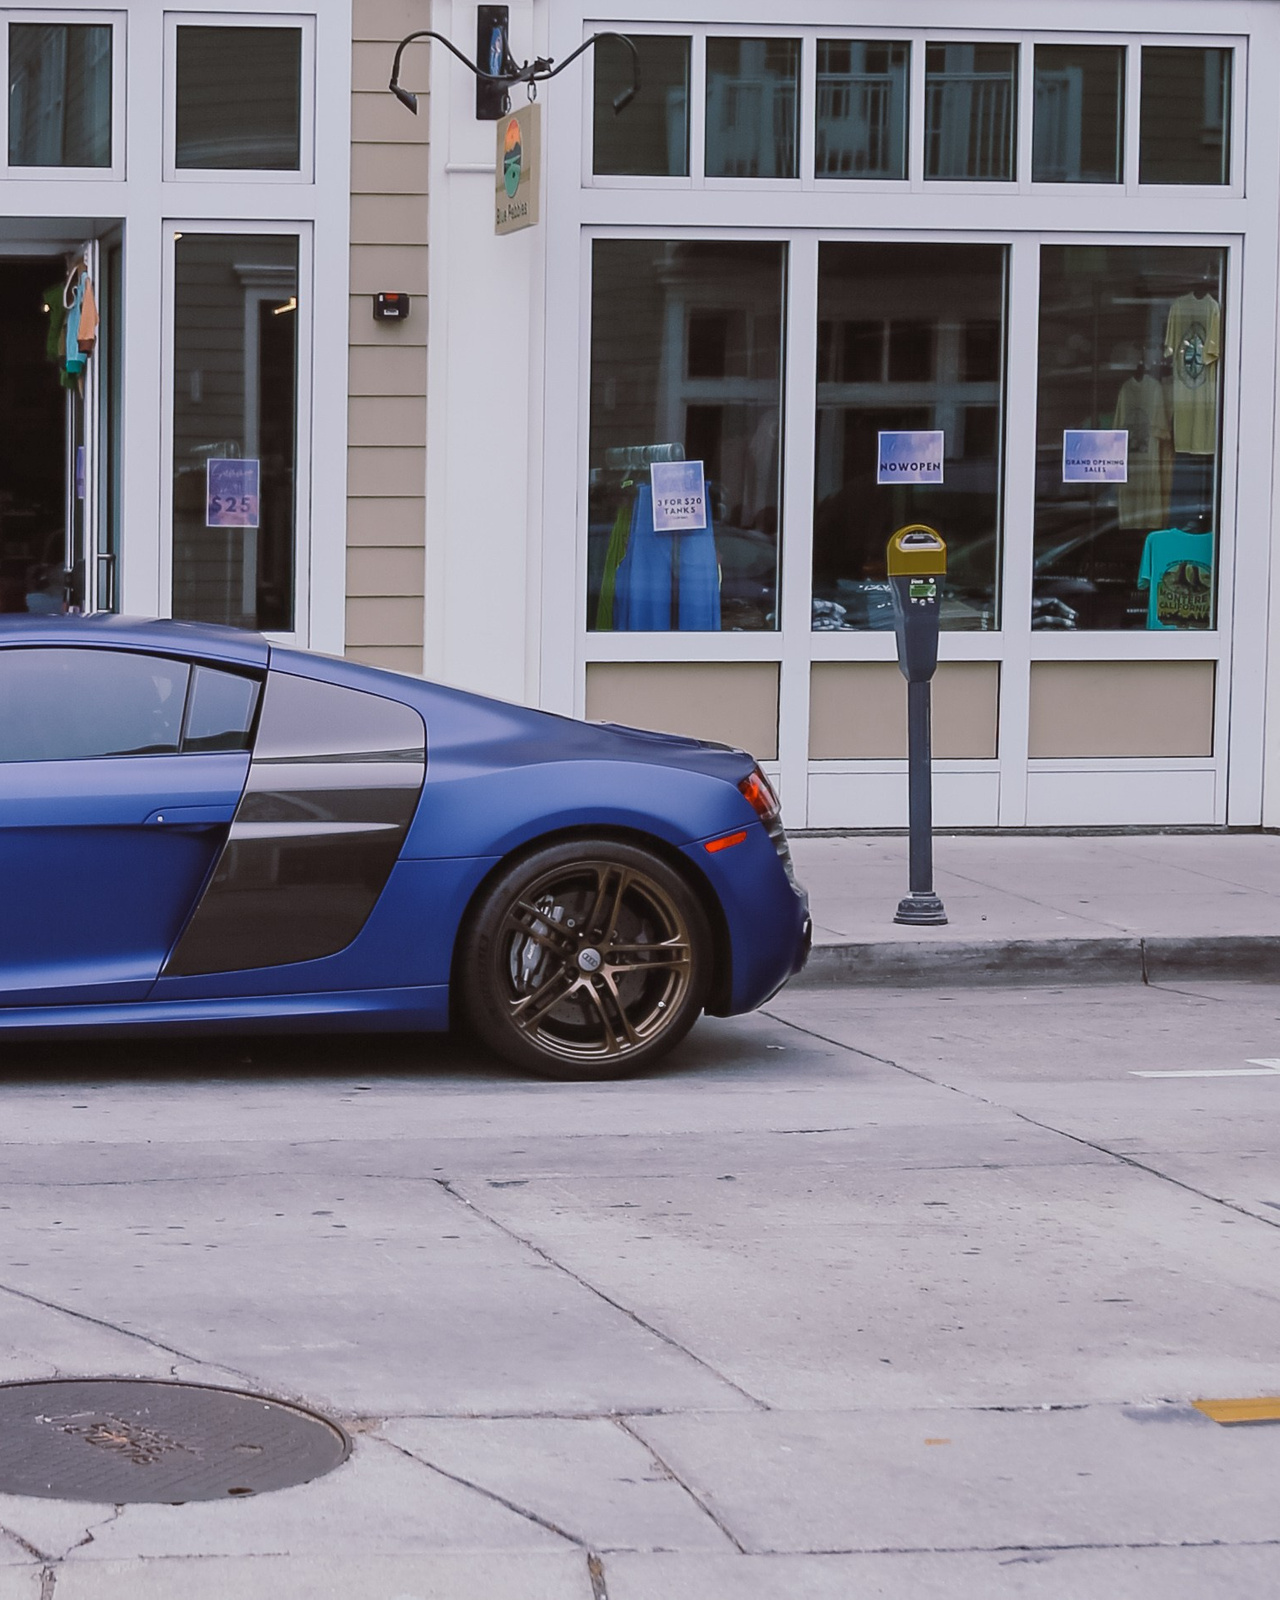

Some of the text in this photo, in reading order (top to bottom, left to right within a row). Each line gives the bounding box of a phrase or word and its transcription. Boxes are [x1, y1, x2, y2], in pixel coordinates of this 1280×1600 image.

[211, 494, 251, 513] $25
[657, 497, 702, 507] 3 FOR $20
[664, 506, 696, 515] TANKS
[1160, 587, 1210, 604] MONTERE
